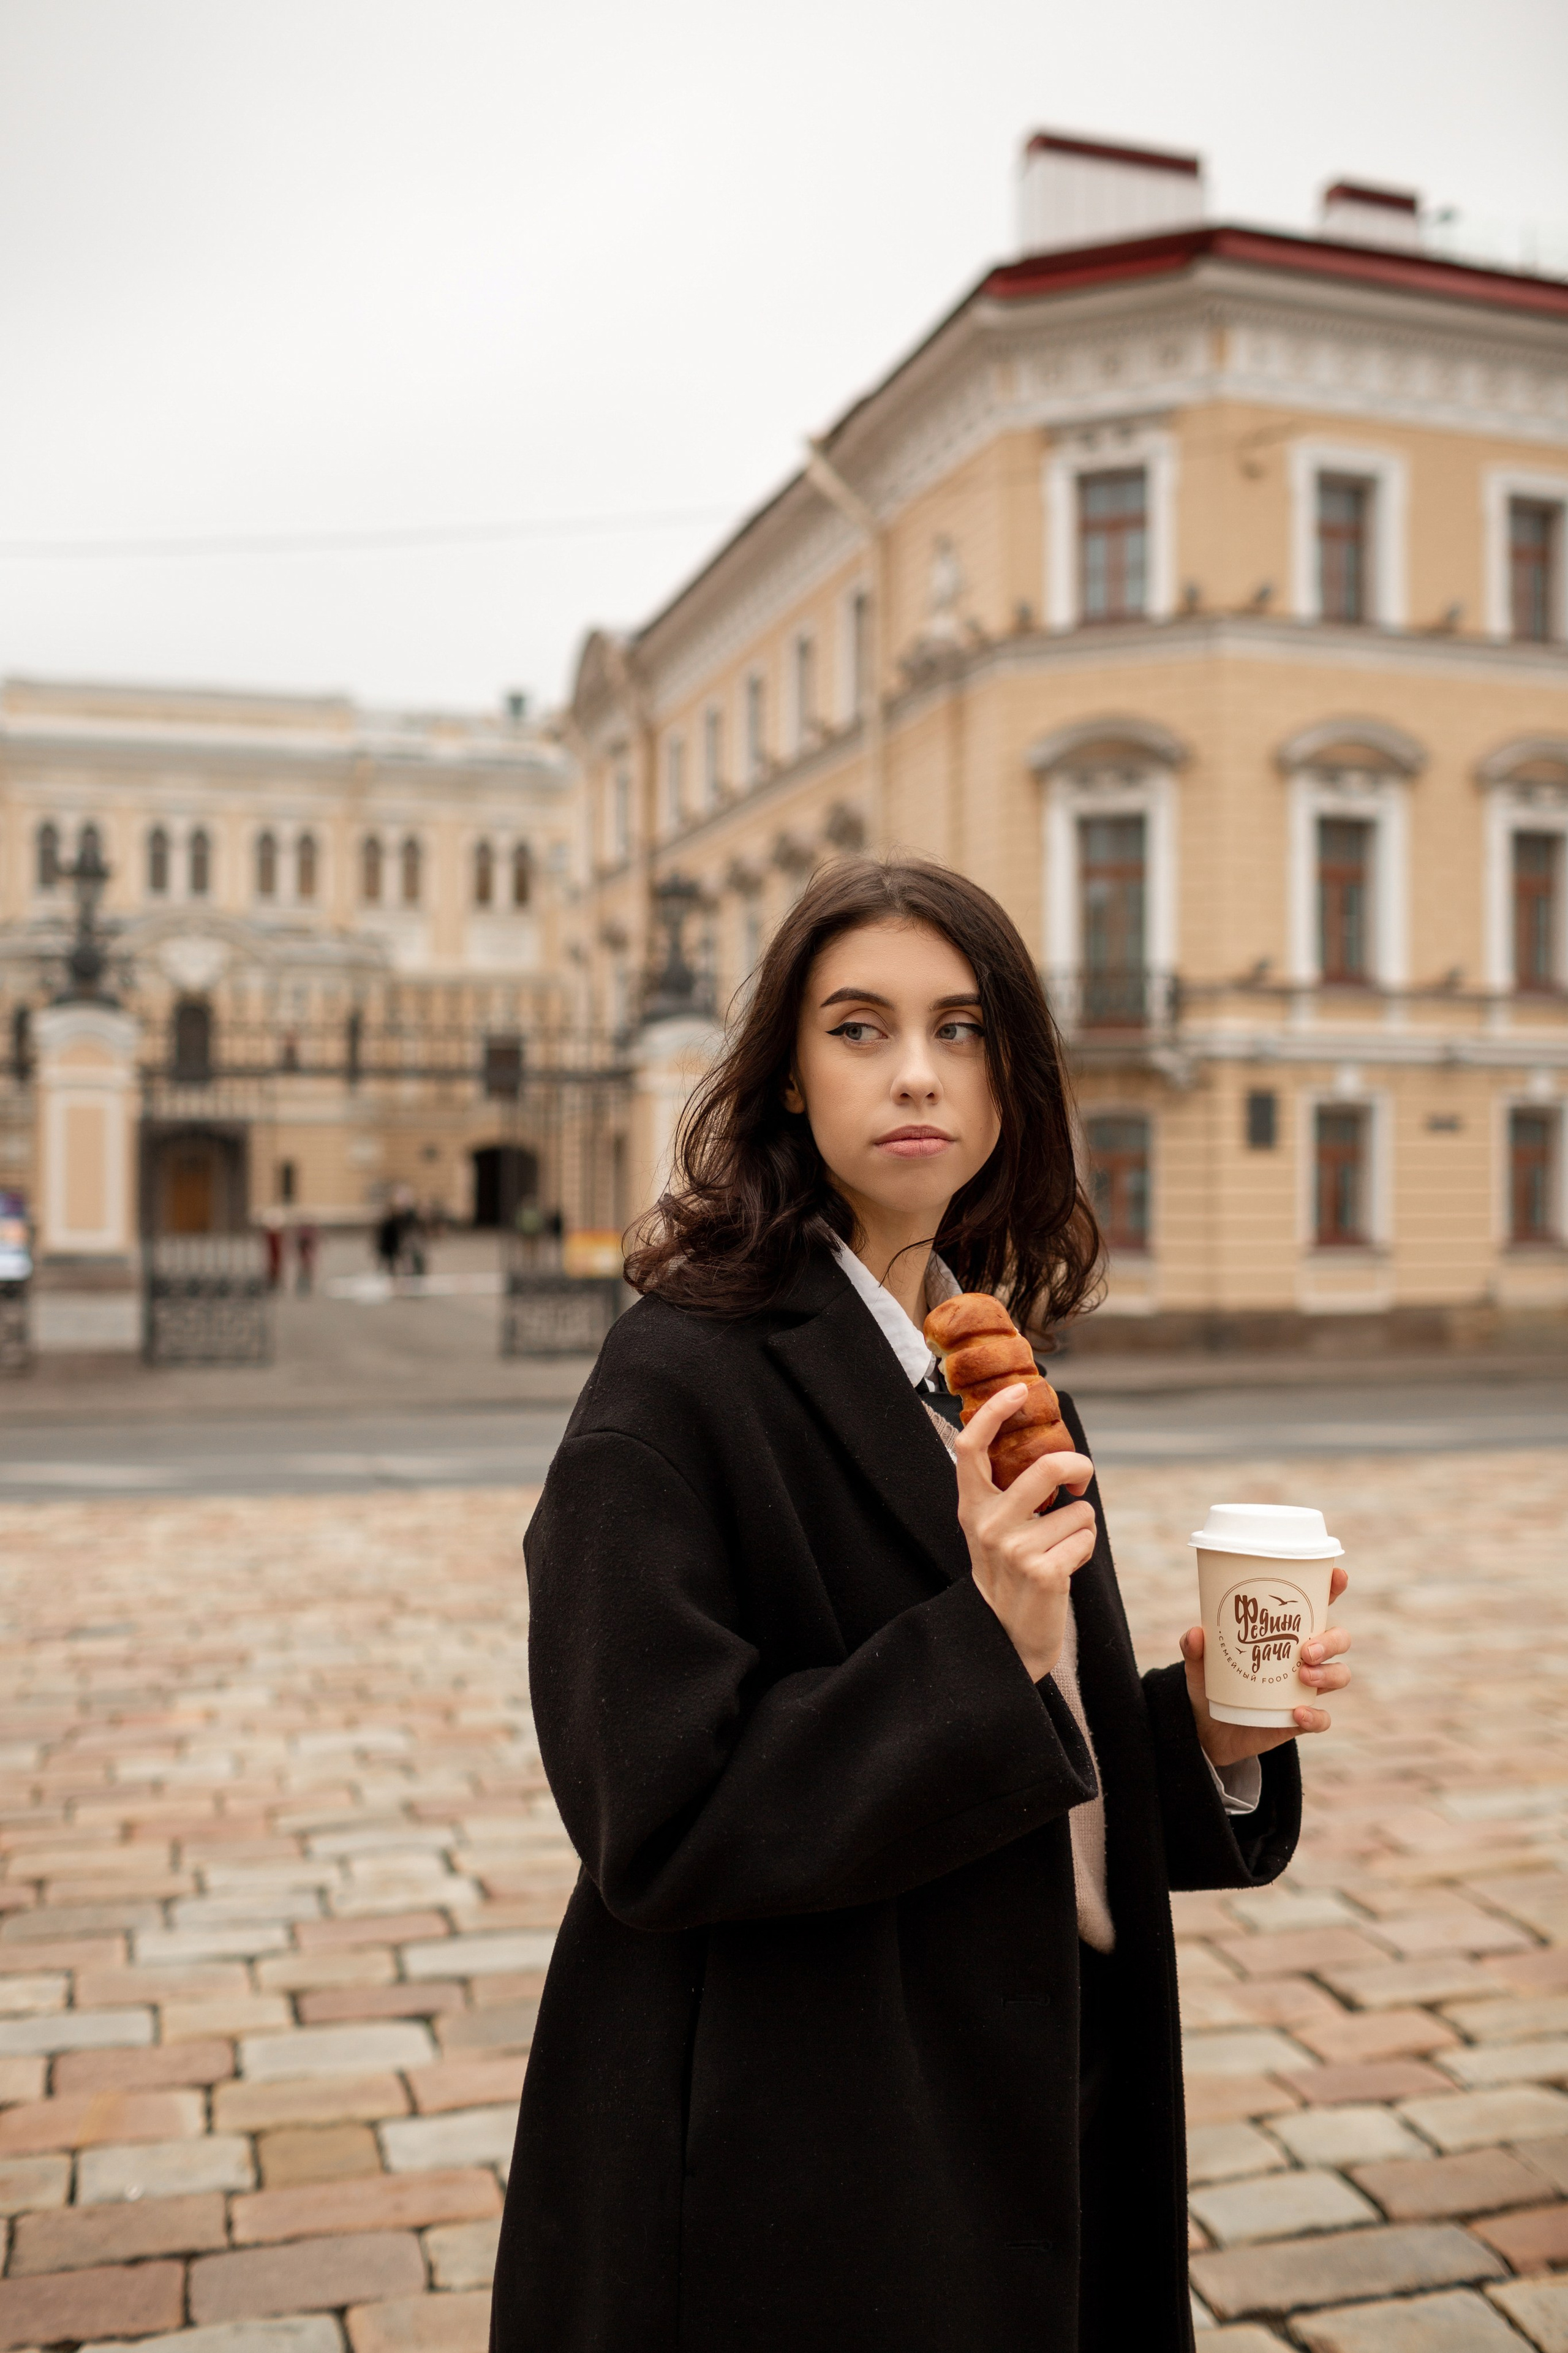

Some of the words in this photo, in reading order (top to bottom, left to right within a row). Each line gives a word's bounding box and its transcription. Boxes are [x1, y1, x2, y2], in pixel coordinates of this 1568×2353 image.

[1235, 1595, 1301, 1644] Федина
[1219, 1636, 1256, 1682] СЕМЕЙНЫЙ
[1262, 1673, 1288, 1683] FOOD
[1292, 1657, 1303, 1672] CO
[1252, 1642, 1291, 1673] дача
